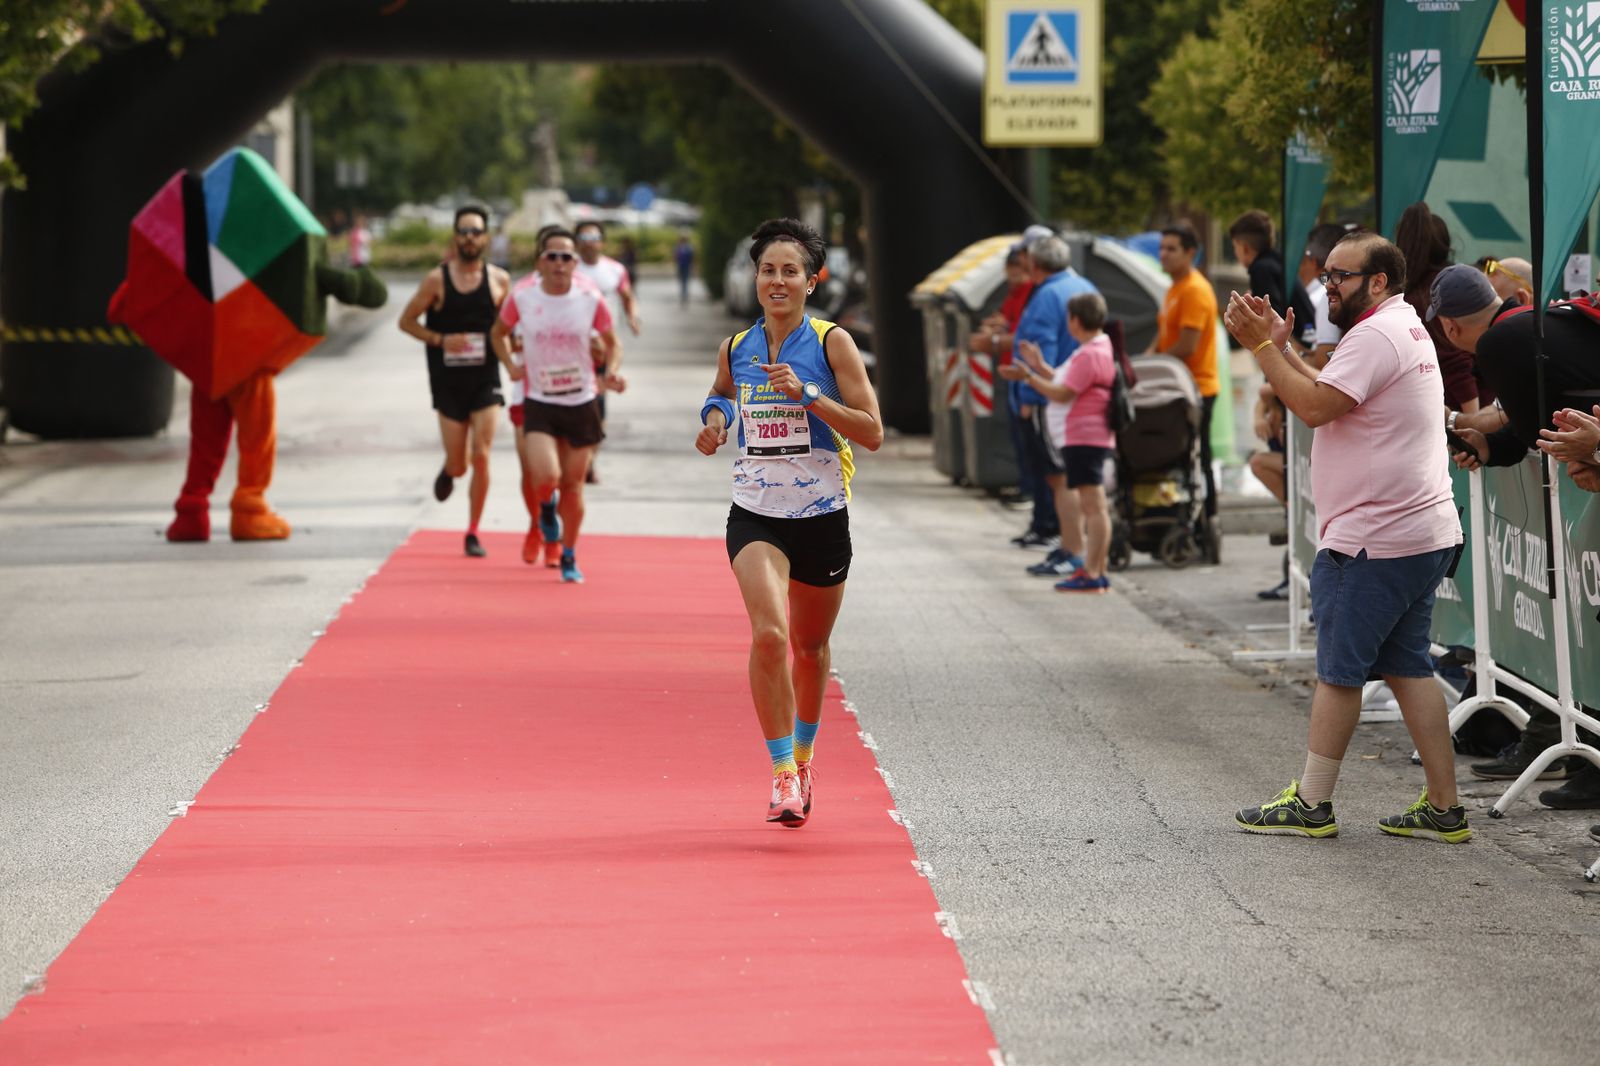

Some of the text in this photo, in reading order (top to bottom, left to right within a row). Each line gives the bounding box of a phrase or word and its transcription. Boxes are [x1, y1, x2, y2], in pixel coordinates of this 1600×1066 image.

[1548, 7, 1558, 79] fundación
[1549, 80, 1583, 92] CAJA
[1566, 91, 1600, 100] GRANA
[1006, 117, 1078, 130] ELEVADA
[751, 410, 805, 419] COVIRAN
[757, 422, 788, 439] 1203
